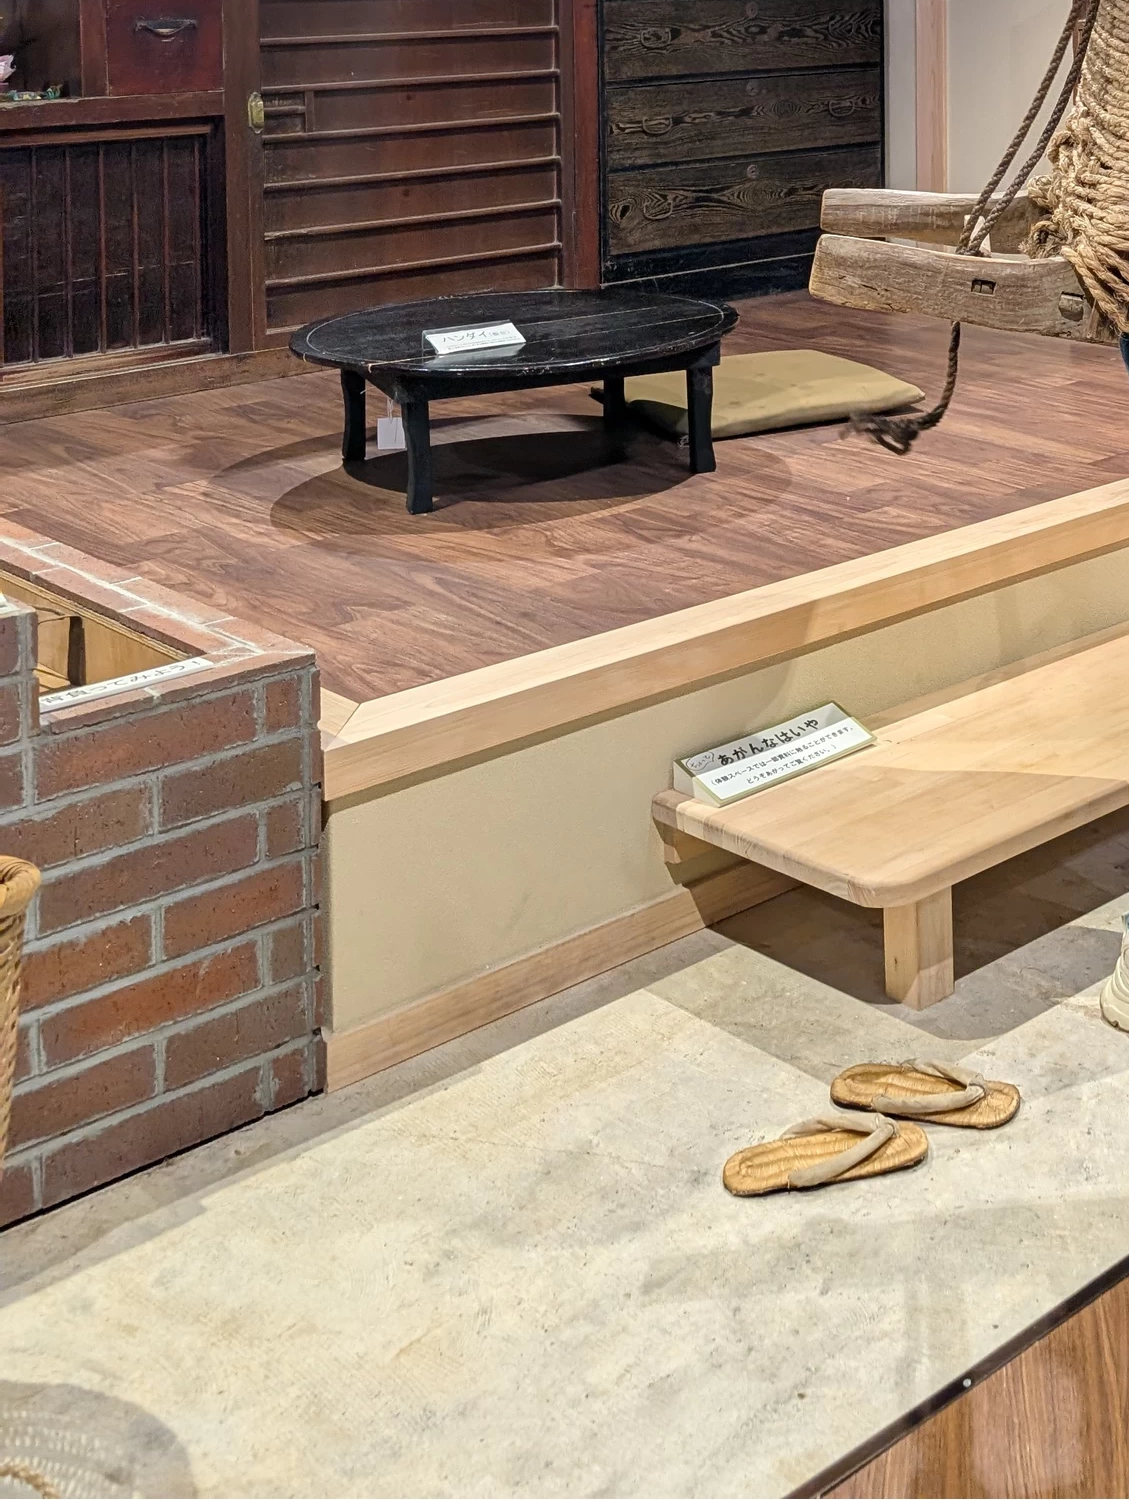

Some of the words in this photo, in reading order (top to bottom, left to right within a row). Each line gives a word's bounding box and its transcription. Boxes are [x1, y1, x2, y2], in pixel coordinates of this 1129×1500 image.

[718, 718, 819, 767] あがんなはいや
